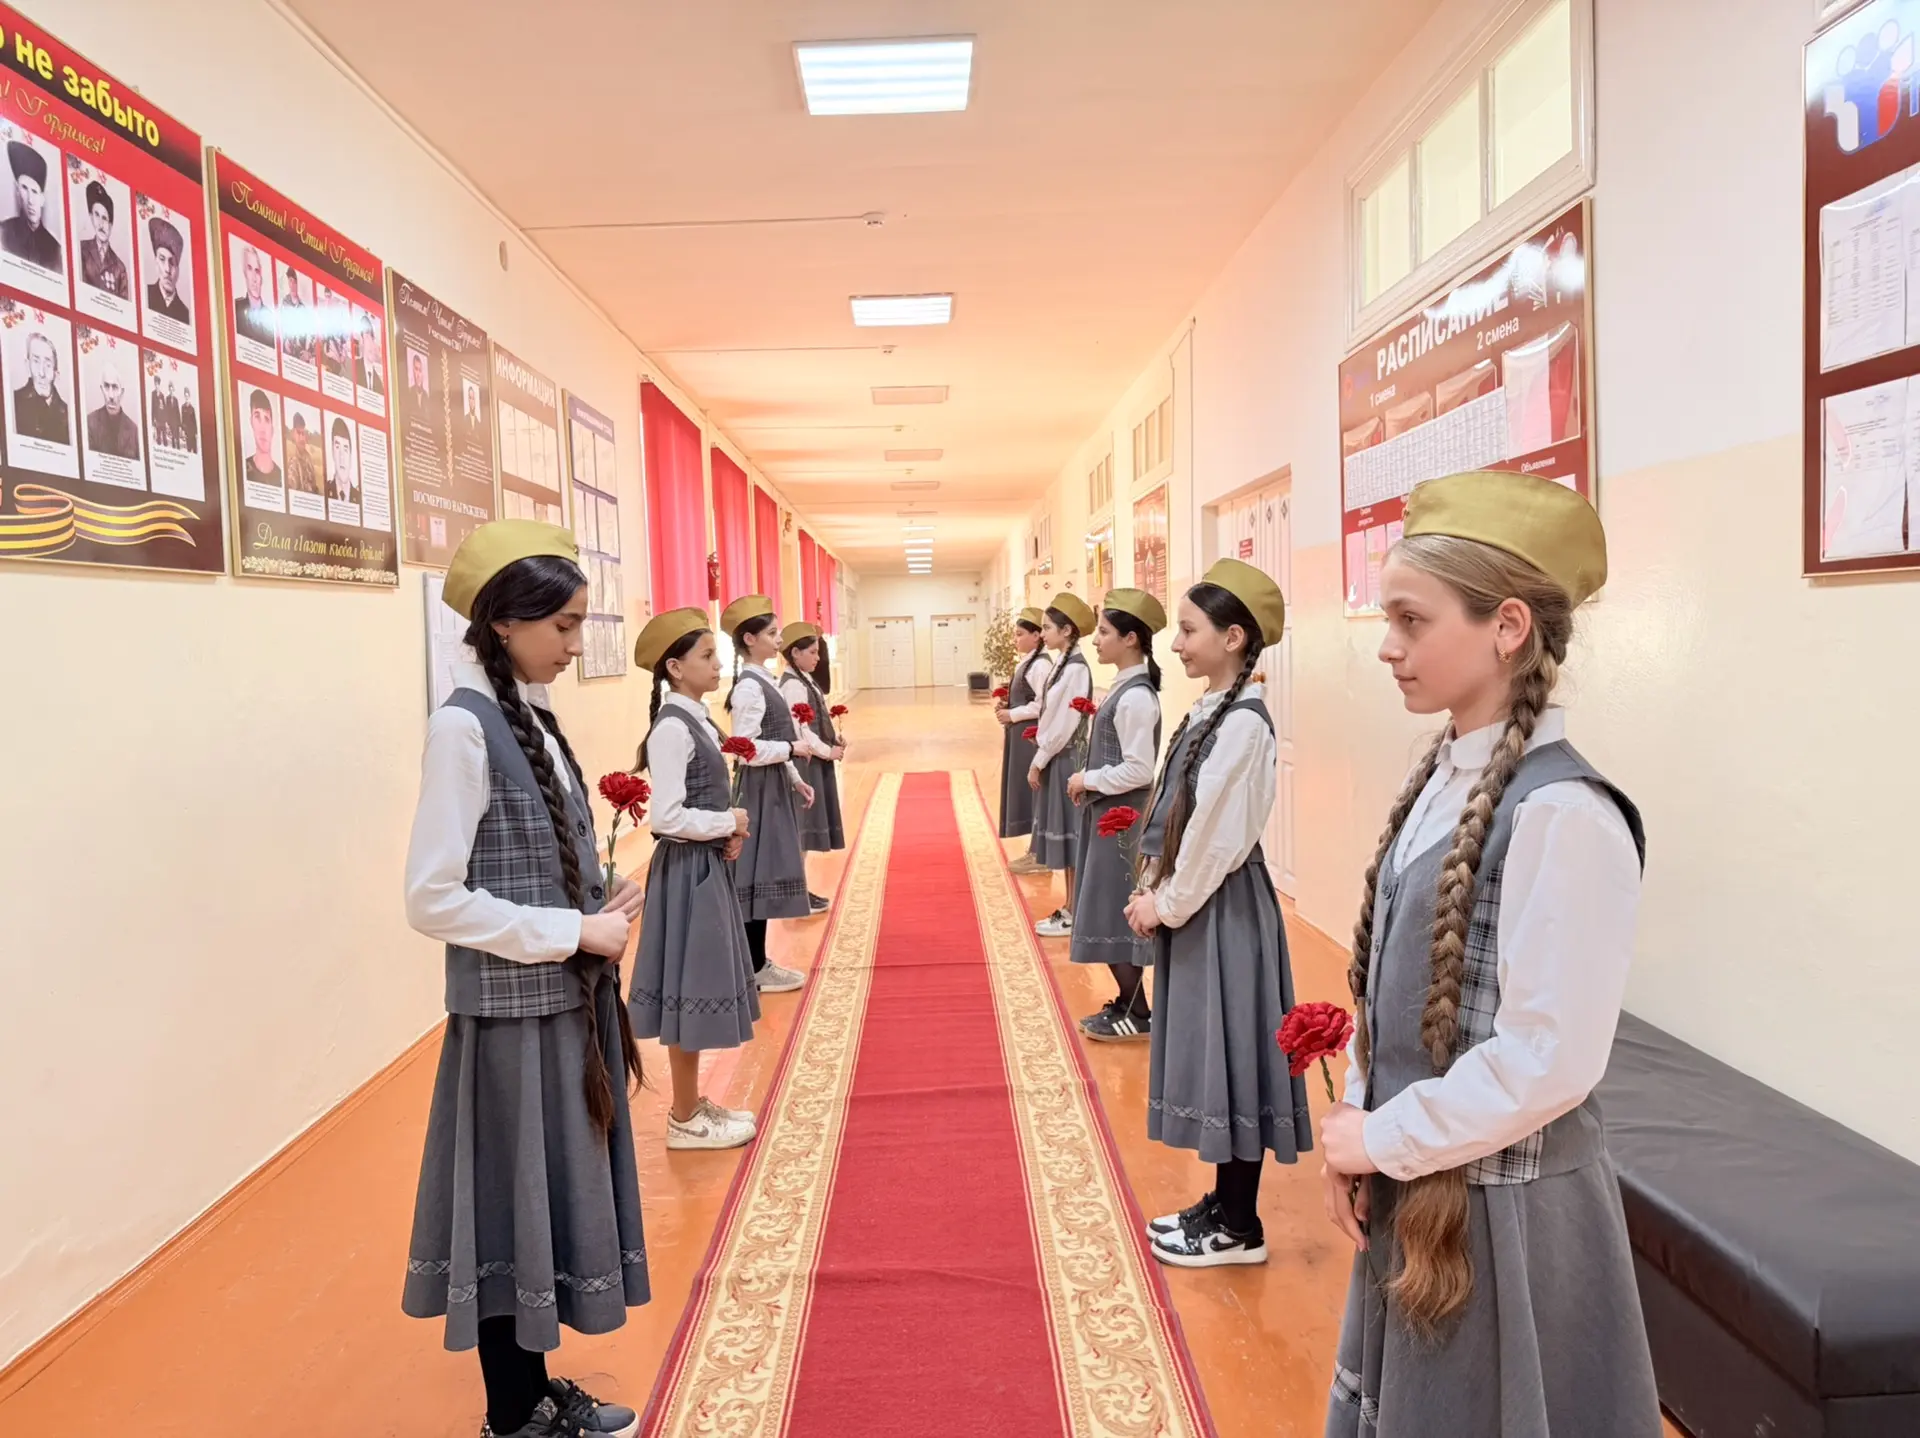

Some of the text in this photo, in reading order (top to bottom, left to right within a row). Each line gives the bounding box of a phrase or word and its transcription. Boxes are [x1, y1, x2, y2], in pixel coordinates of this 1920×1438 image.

[15, 31, 160, 147] не забыто
[15, 87, 106, 154] Гордимся!
[231, 181, 375, 286] Помним! Чтим! Гордимся!
[1476, 316, 1520, 351] 2 смена
[495, 351, 555, 409] ИНФОРМАЦИЯ
[1375, 384, 1396, 406] смена
[253, 522, 291, 550] Дала
